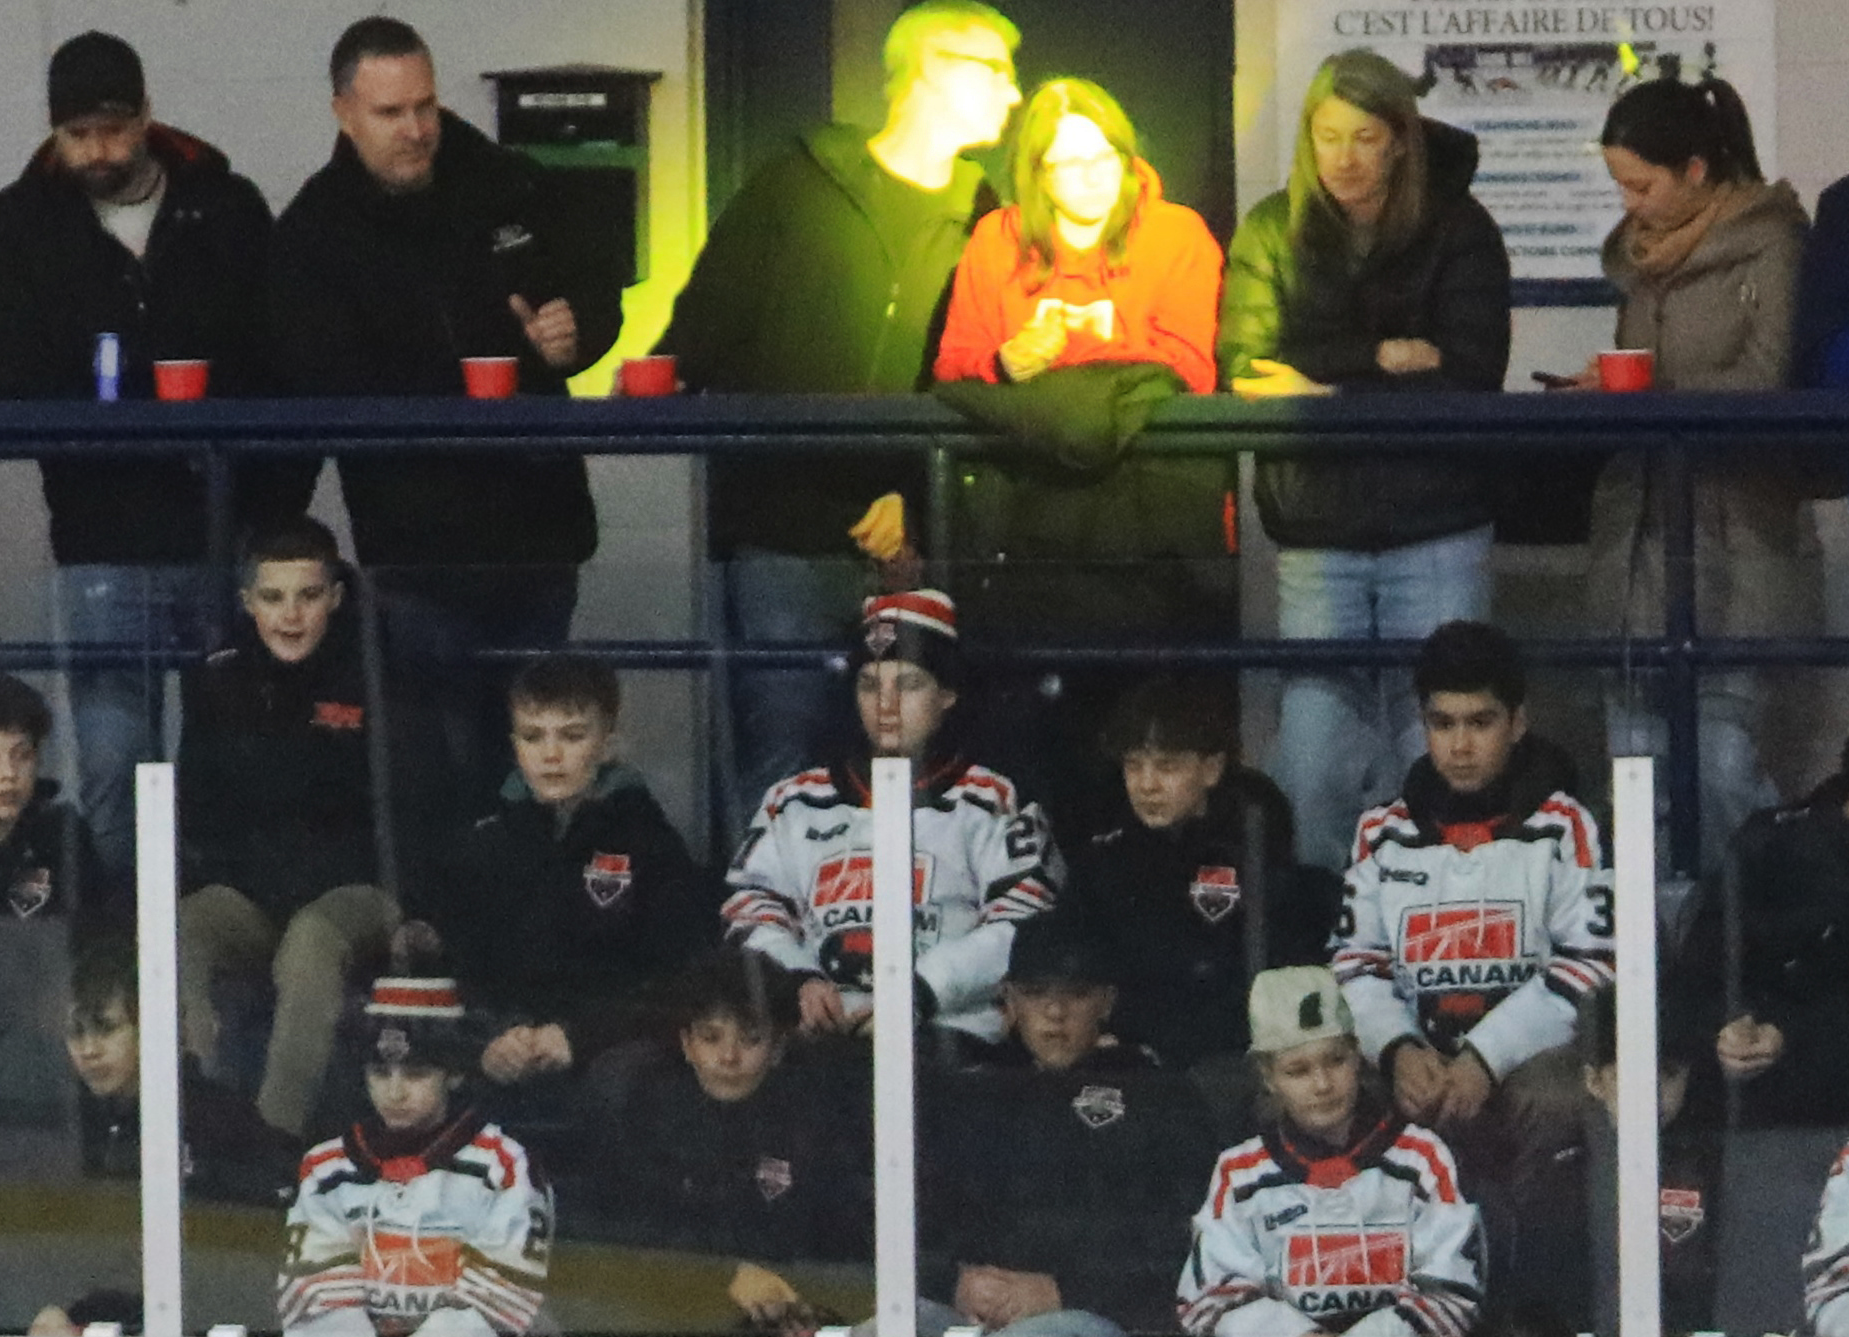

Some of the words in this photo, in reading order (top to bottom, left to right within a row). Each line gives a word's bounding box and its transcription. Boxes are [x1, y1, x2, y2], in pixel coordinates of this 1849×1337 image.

[1334, 8, 1409, 36] C'EST
[1421, 8, 1568, 35] L'AFFAIRE
[1627, 4, 1714, 32] TOUS!
[1416, 962, 1539, 988] CANAM
[1299, 1290, 1398, 1313] CANA
